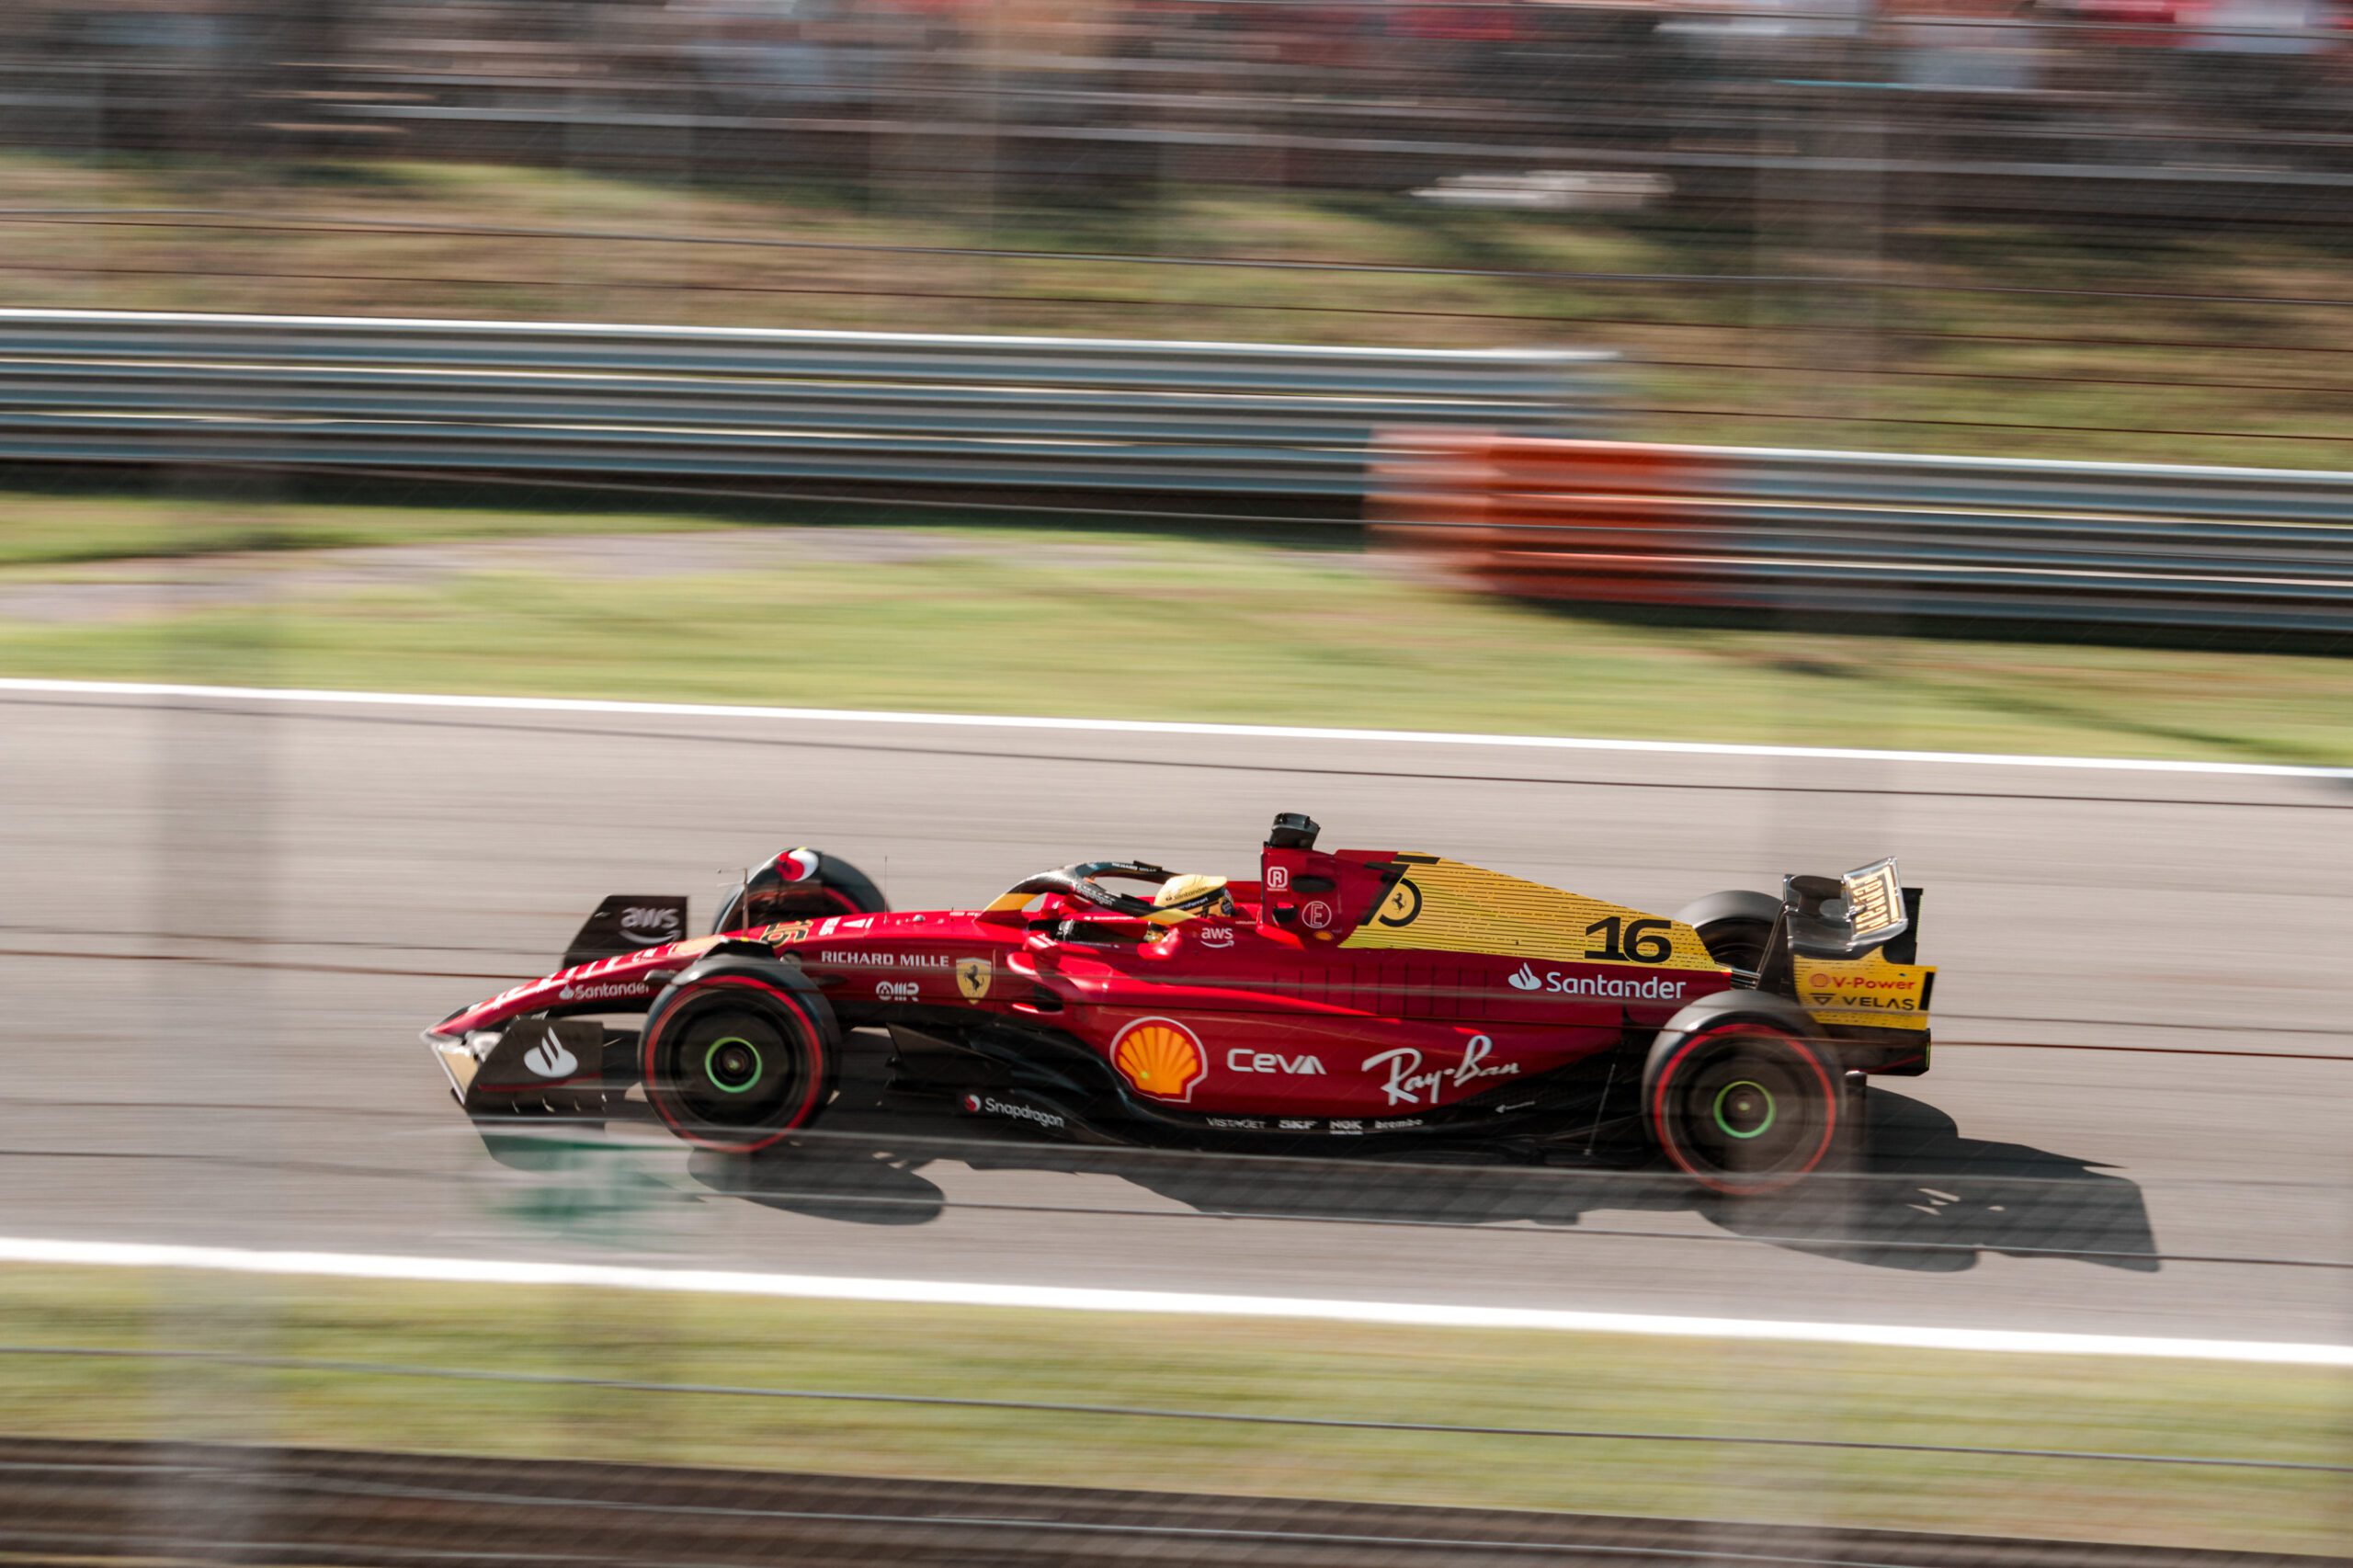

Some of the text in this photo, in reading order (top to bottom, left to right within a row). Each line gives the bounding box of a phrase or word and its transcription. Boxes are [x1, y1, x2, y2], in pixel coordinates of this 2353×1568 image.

[620, 906, 679, 928] aws
[1200, 927, 1233, 939] aws
[1585, 916, 1672, 963] 16
[821, 950, 949, 967] RICHARD MILLE
[1546, 971, 1687, 999] Santander
[1833, 975, 1915, 990] V-Power
[1843, 995, 1915, 1011] VELAS
[1361, 1034, 1520, 1106] Ray-Ban
[984, 1097, 1064, 1128] Snapdragon
[1375, 1118, 1424, 1130] brembo
